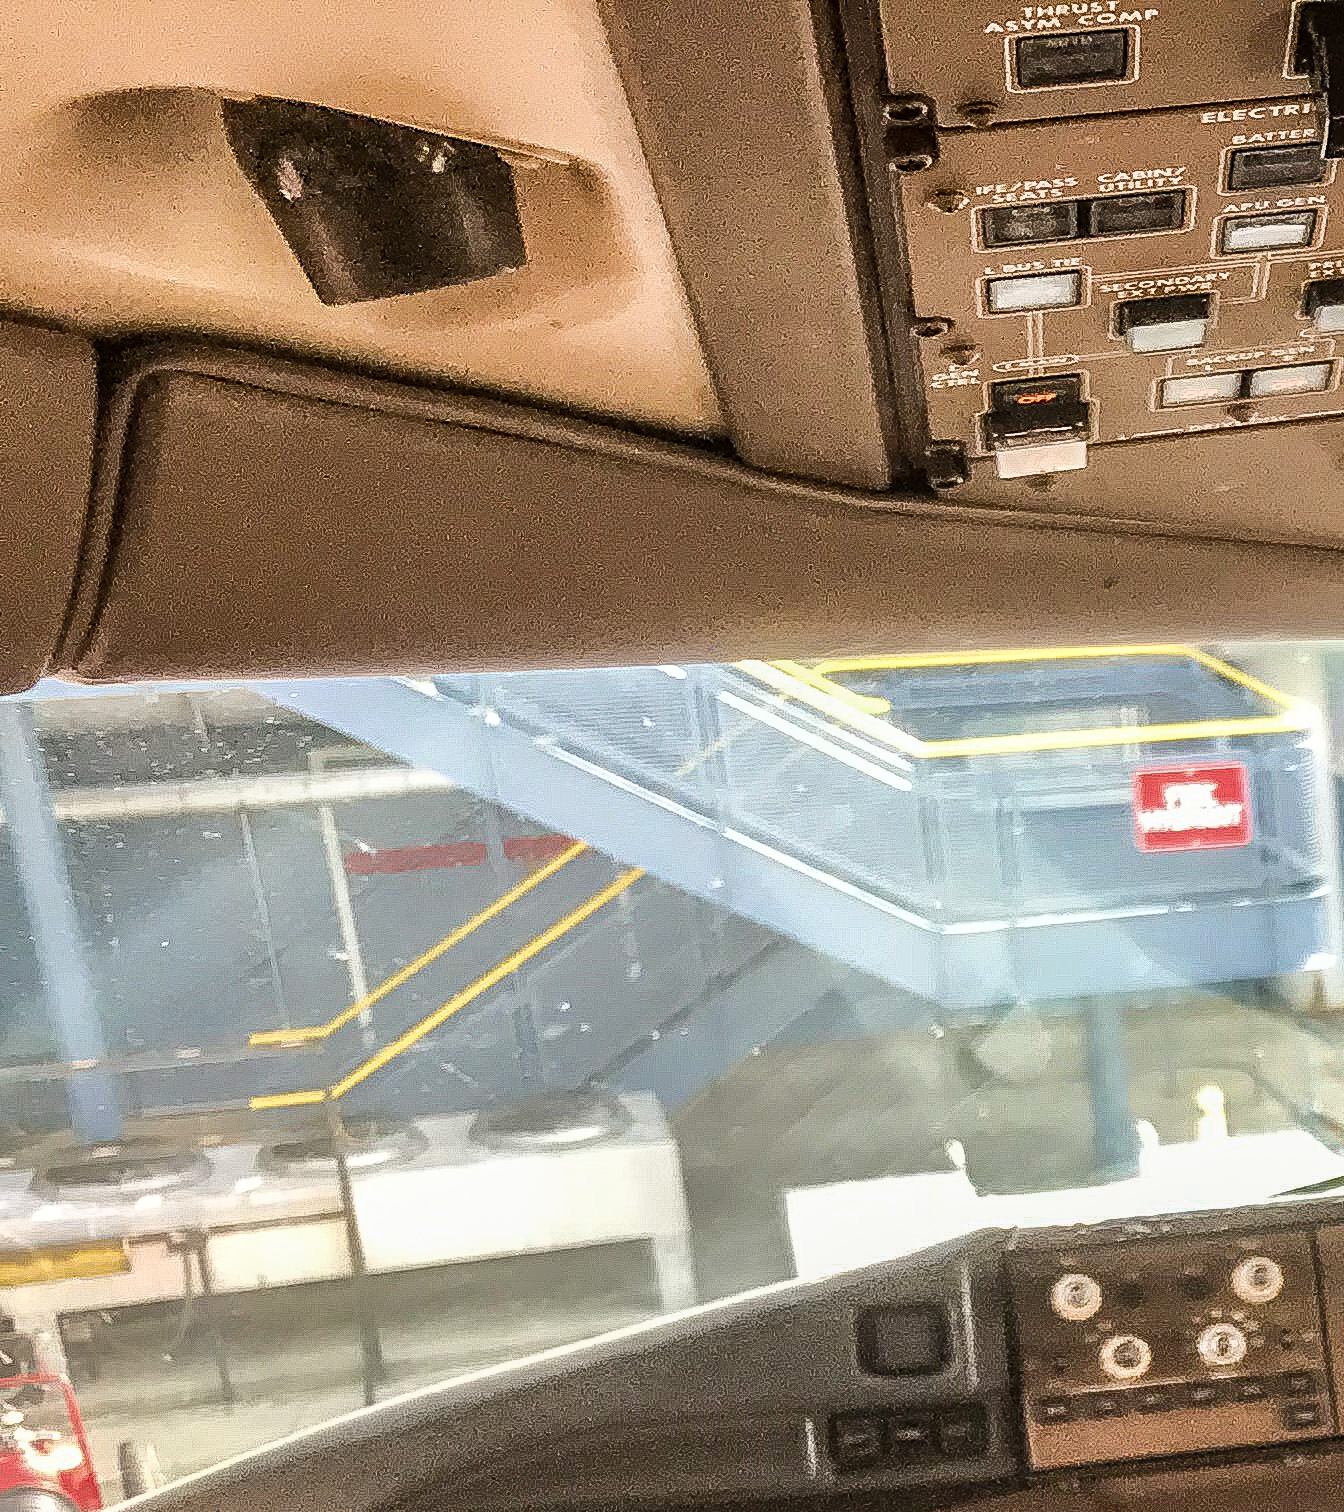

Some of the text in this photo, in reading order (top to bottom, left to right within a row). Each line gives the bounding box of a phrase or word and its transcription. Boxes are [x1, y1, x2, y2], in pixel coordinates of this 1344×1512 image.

[1023, 1, 1120, 17] THRUST
[984, 10, 1158, 33] ASYM COMP
[1202, 105, 1313, 122] ELECTRI
[1232, 129, 1314, 145] BATTER
[1098, 177, 1183, 192] UTILITY
[1222, 196, 1326, 212] APU GEN
[1002, 262, 1043, 274] BUS
[1052, 258, 1081, 267] TIE
[1100, 272, 1231, 293] SECONDARY
[1017, 392, 1056, 403] OFF
